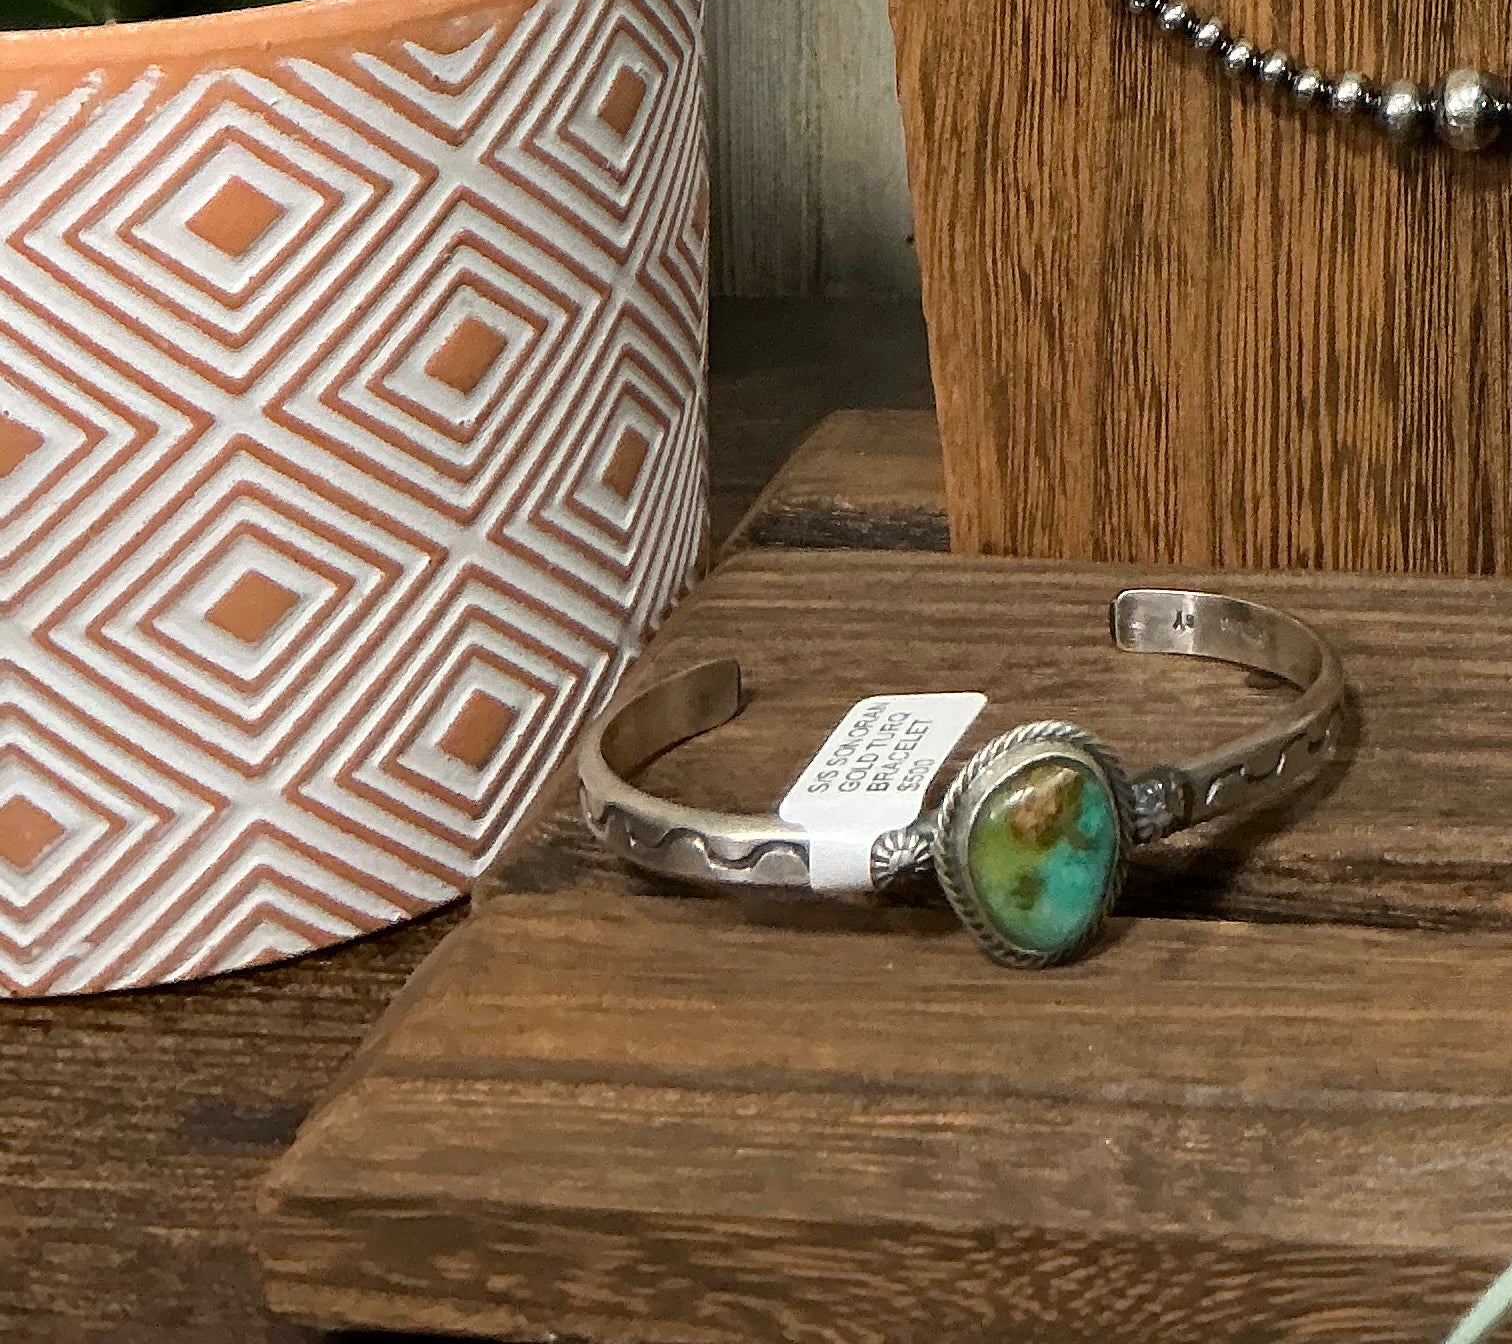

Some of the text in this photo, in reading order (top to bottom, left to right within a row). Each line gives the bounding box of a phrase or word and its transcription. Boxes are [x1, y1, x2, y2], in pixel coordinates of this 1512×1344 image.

[826, 702, 889, 766] SONORAN
[838, 712, 910, 792] GOLD TURQ
[866, 719, 933, 792] BRACELET
